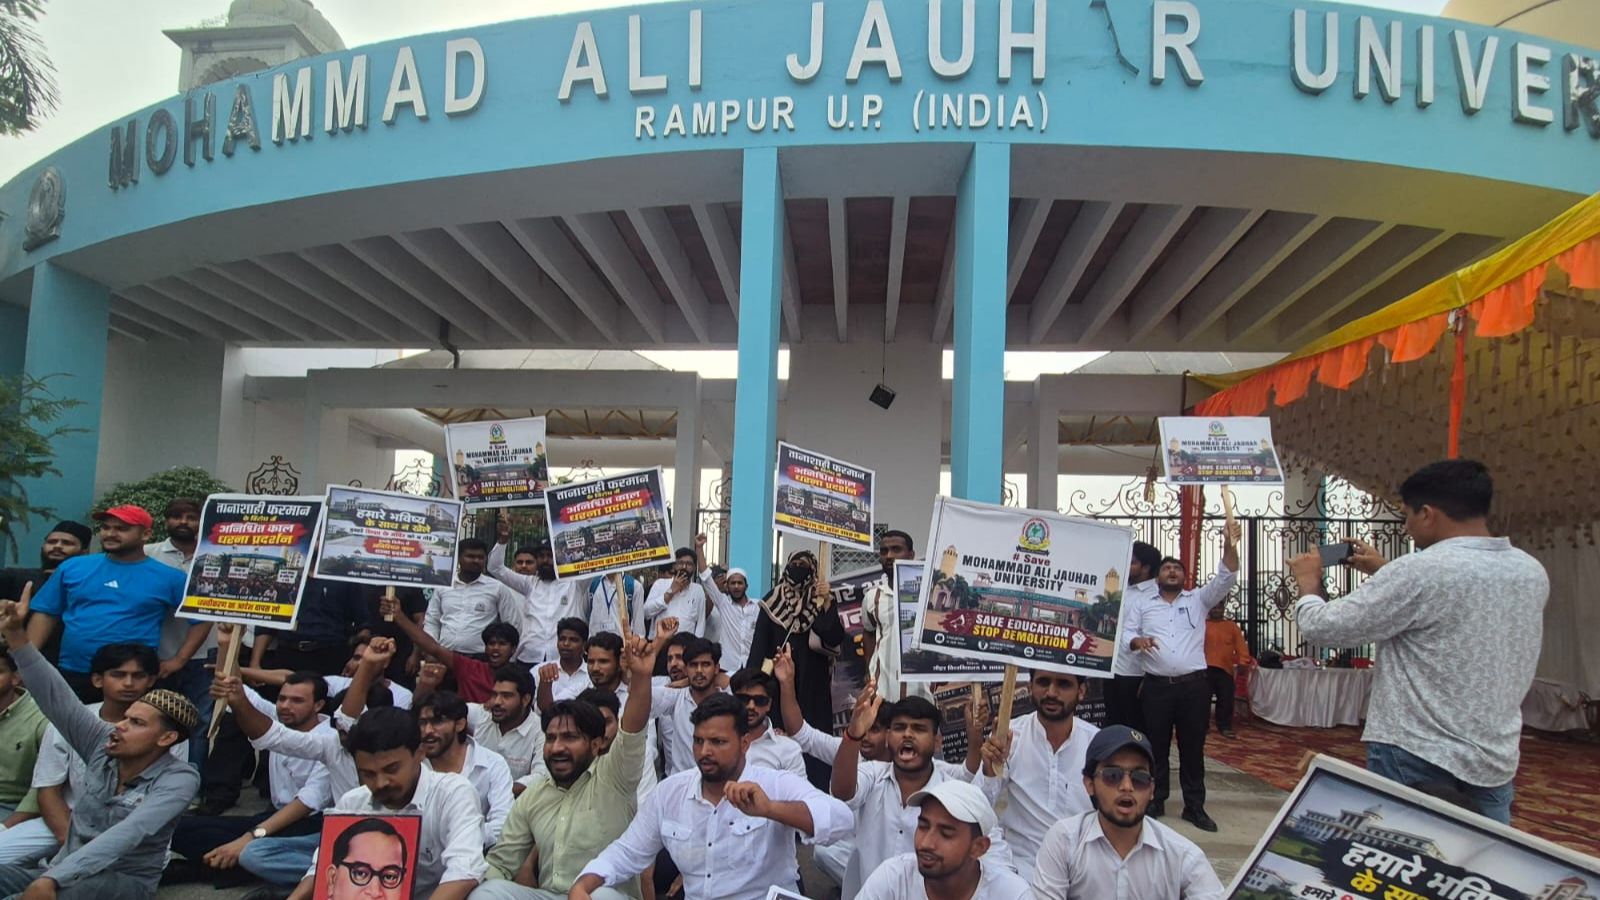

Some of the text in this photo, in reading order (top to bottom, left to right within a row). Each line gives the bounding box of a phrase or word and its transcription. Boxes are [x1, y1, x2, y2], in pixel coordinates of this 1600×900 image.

[108, 37, 486, 190] MOHAMMAD
[558, 9, 702, 101] ALI
[785, 0, 1204, 86] JAUHR
[635, 89, 1049, 138] RAMPUR U.P. (INDIA)
[466, 450, 500, 459] MOHAMMAD
[511, 447, 533, 455] JAUHAR
[483, 455, 518, 464] UNIVERSITY
[216, 501, 312, 516] तानाशाही फरमान
[356, 508, 427, 525] हमारे भविष्य
[267, 524, 295, 533] काल
[365, 517, 376, 527] के
[217, 533, 294, 544] धरना प्रदर्शन
[1024, 554, 1050, 566] Save
[962, 555, 1098, 586] MOHAMMAD ALI JAUHAR
[993, 571, 1064, 592] UNIVERSITY
[976, 614, 1070, 638] SAVE EDUCATION
[972, 625, 1000, 639] STOP
[1002, 631, 1069, 649] DEMOLITION
[1341, 842, 1427, 885] हमारे
[1350, 868, 1383, 893] के
